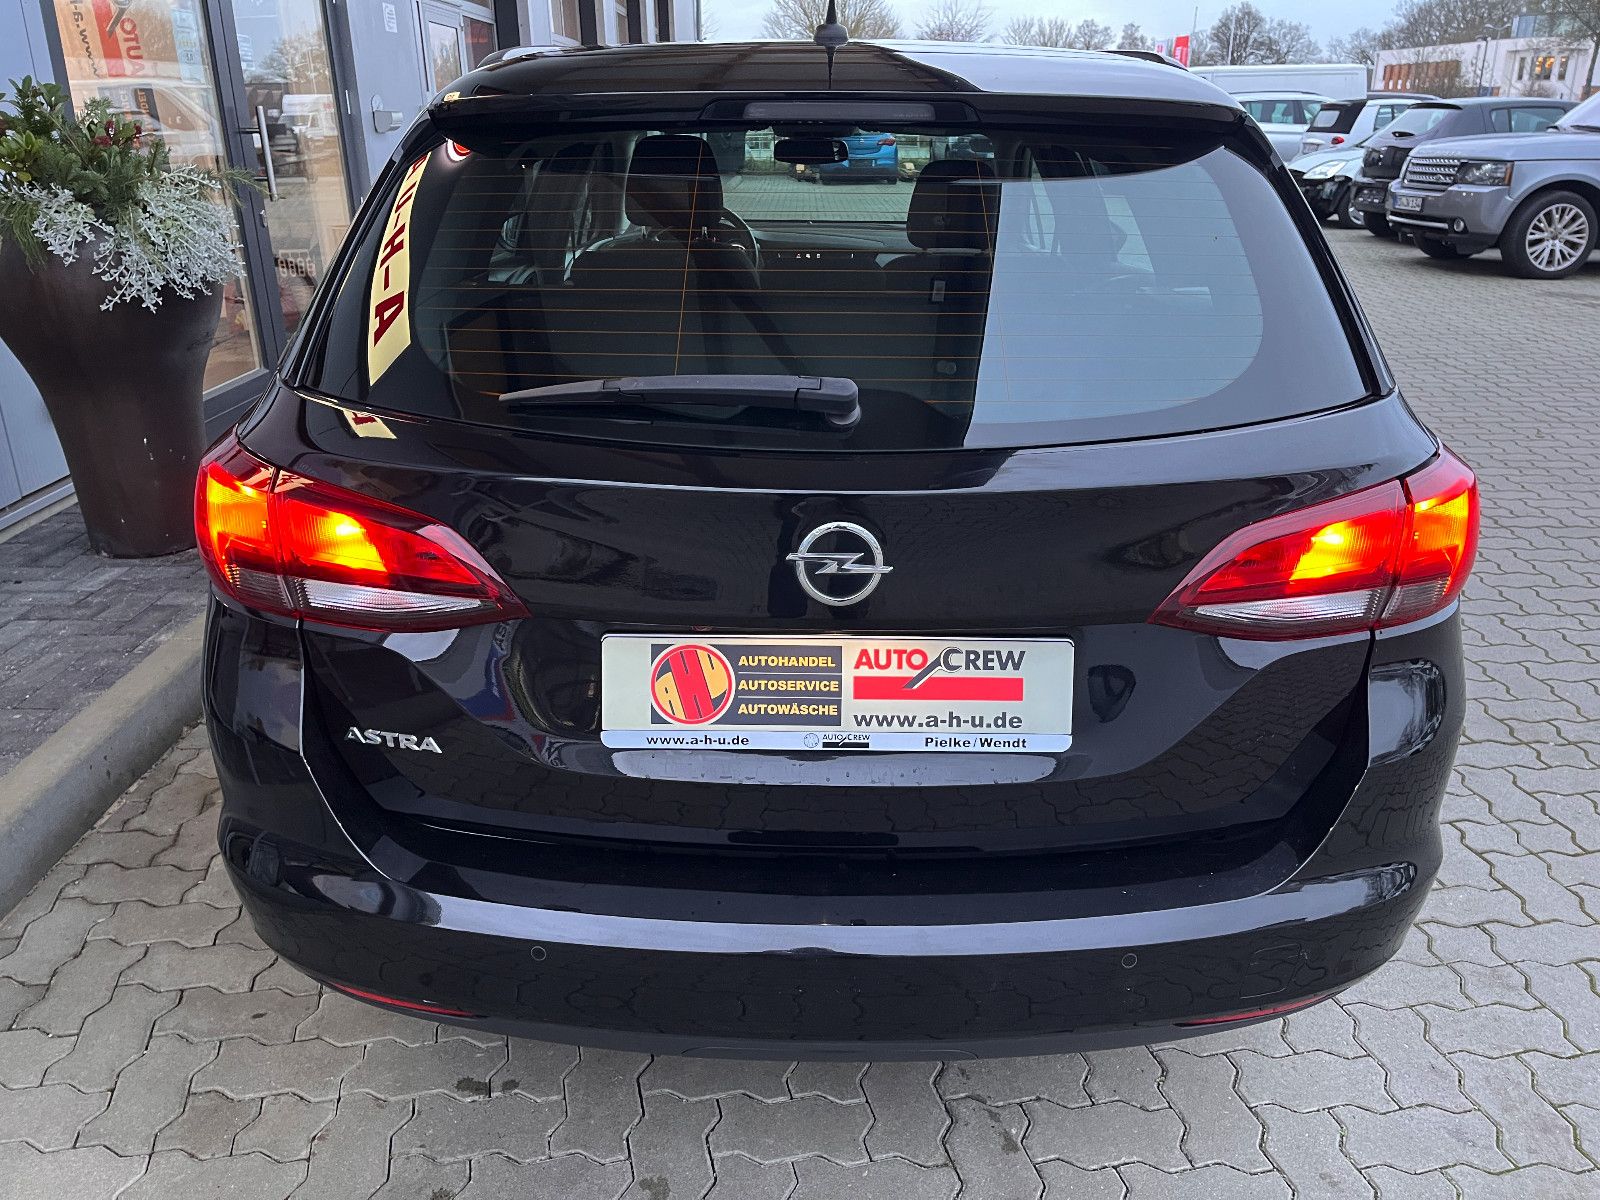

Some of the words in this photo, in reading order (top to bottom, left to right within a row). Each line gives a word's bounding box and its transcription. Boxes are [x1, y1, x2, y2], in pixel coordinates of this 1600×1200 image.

[738, 655, 836, 667] AUTOHANDEL
[853, 648, 928, 670] AUTO
[942, 649, 1026, 671] CREW
[738, 679, 839, 691] AUTOSERVICE
[738, 702, 838, 715] AUTOWÄSCHE
[853, 711, 1023, 729] www.a-h-u.de
[344, 726, 443, 754] ASTRA
[646, 735, 750, 746] www.a-h-u.de
[822, 733, 844, 741] AUTO
[847, 733, 871, 741] CREW
